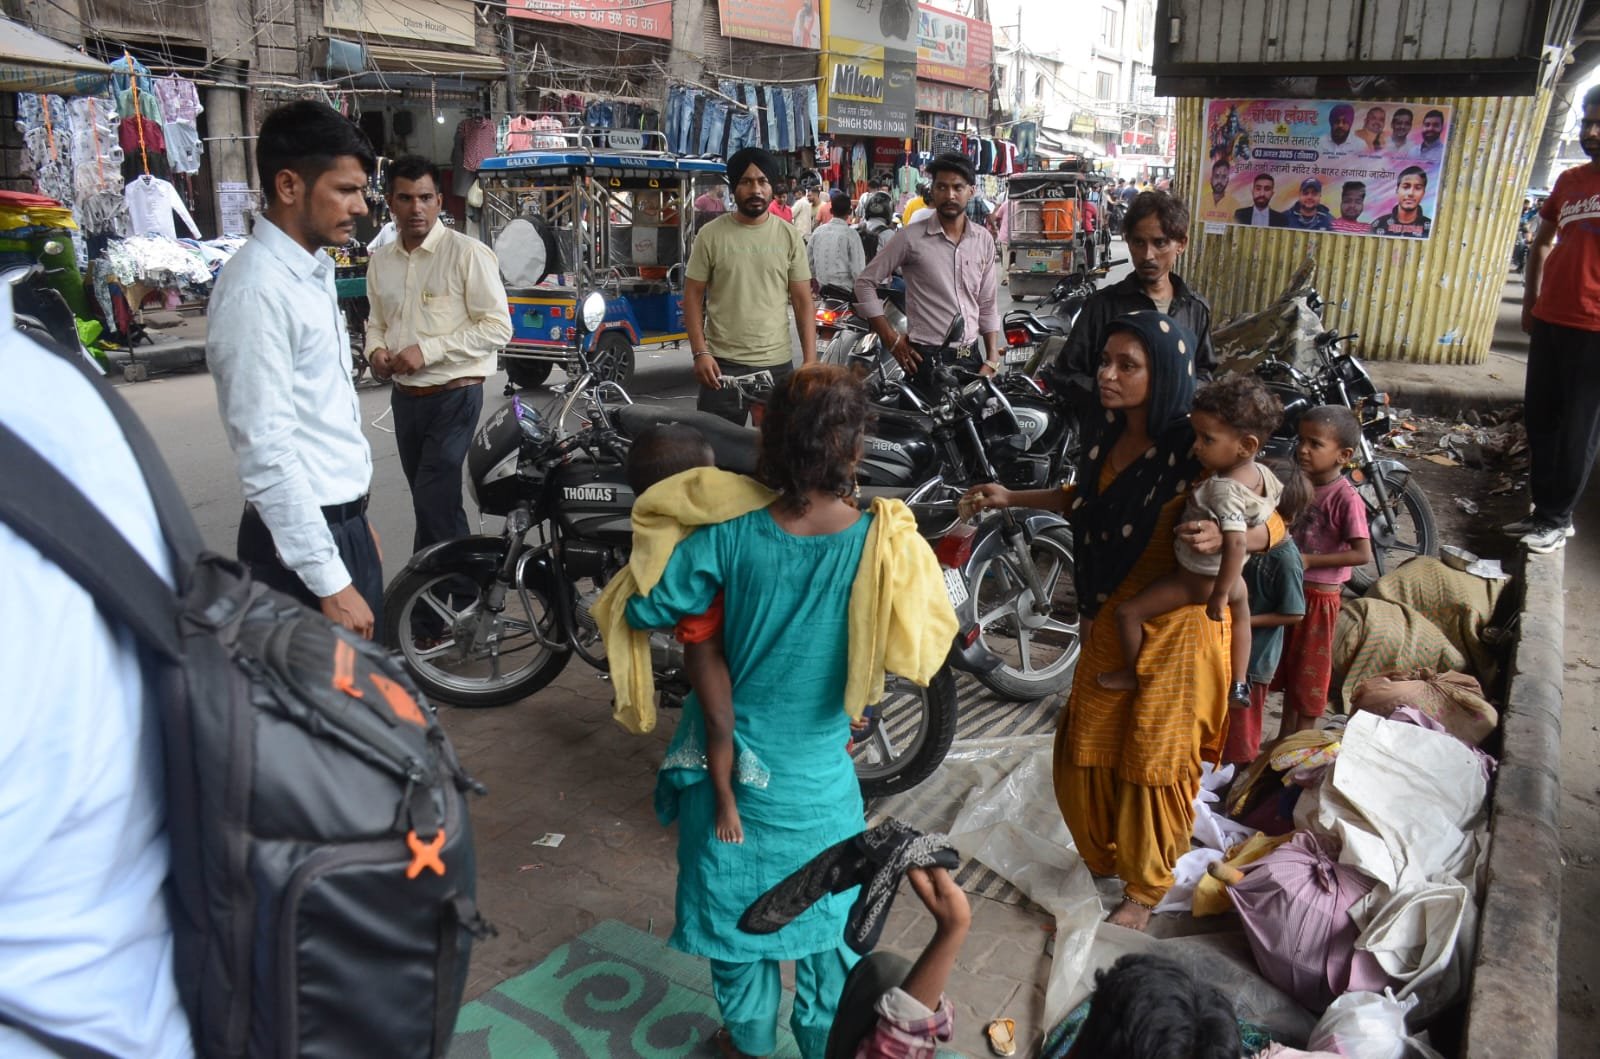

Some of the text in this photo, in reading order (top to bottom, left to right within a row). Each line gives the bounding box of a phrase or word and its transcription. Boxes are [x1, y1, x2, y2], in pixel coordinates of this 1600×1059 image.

[591, 3, 604, 24] ਕੇਸ
[625, 10, 638, 28] ਰਹੇ
[425, 19, 447, 33] House
[831, 63, 884, 98] Nikon
[1284, 105, 1320, 126] लंगर
[838, 116, 907, 134] SINGH SONS (INDIA)
[610, 135, 641, 145] GALAXY
[1266, 131, 1290, 145] वितरण
[1291, 135, 1320, 148] समारोह
[506, 156, 539, 167] GALAXY
[619, 157, 648, 166] GALAXY
[1270, 163, 1290, 174] स्वामी
[1292, 163, 1311, 174] मंदिर
[1341, 168, 1367, 178] लगाया
[1018, 420, 1036, 429] ero
[871, 439, 902, 451] Hero
[562, 487, 612, 501] THOMAS
